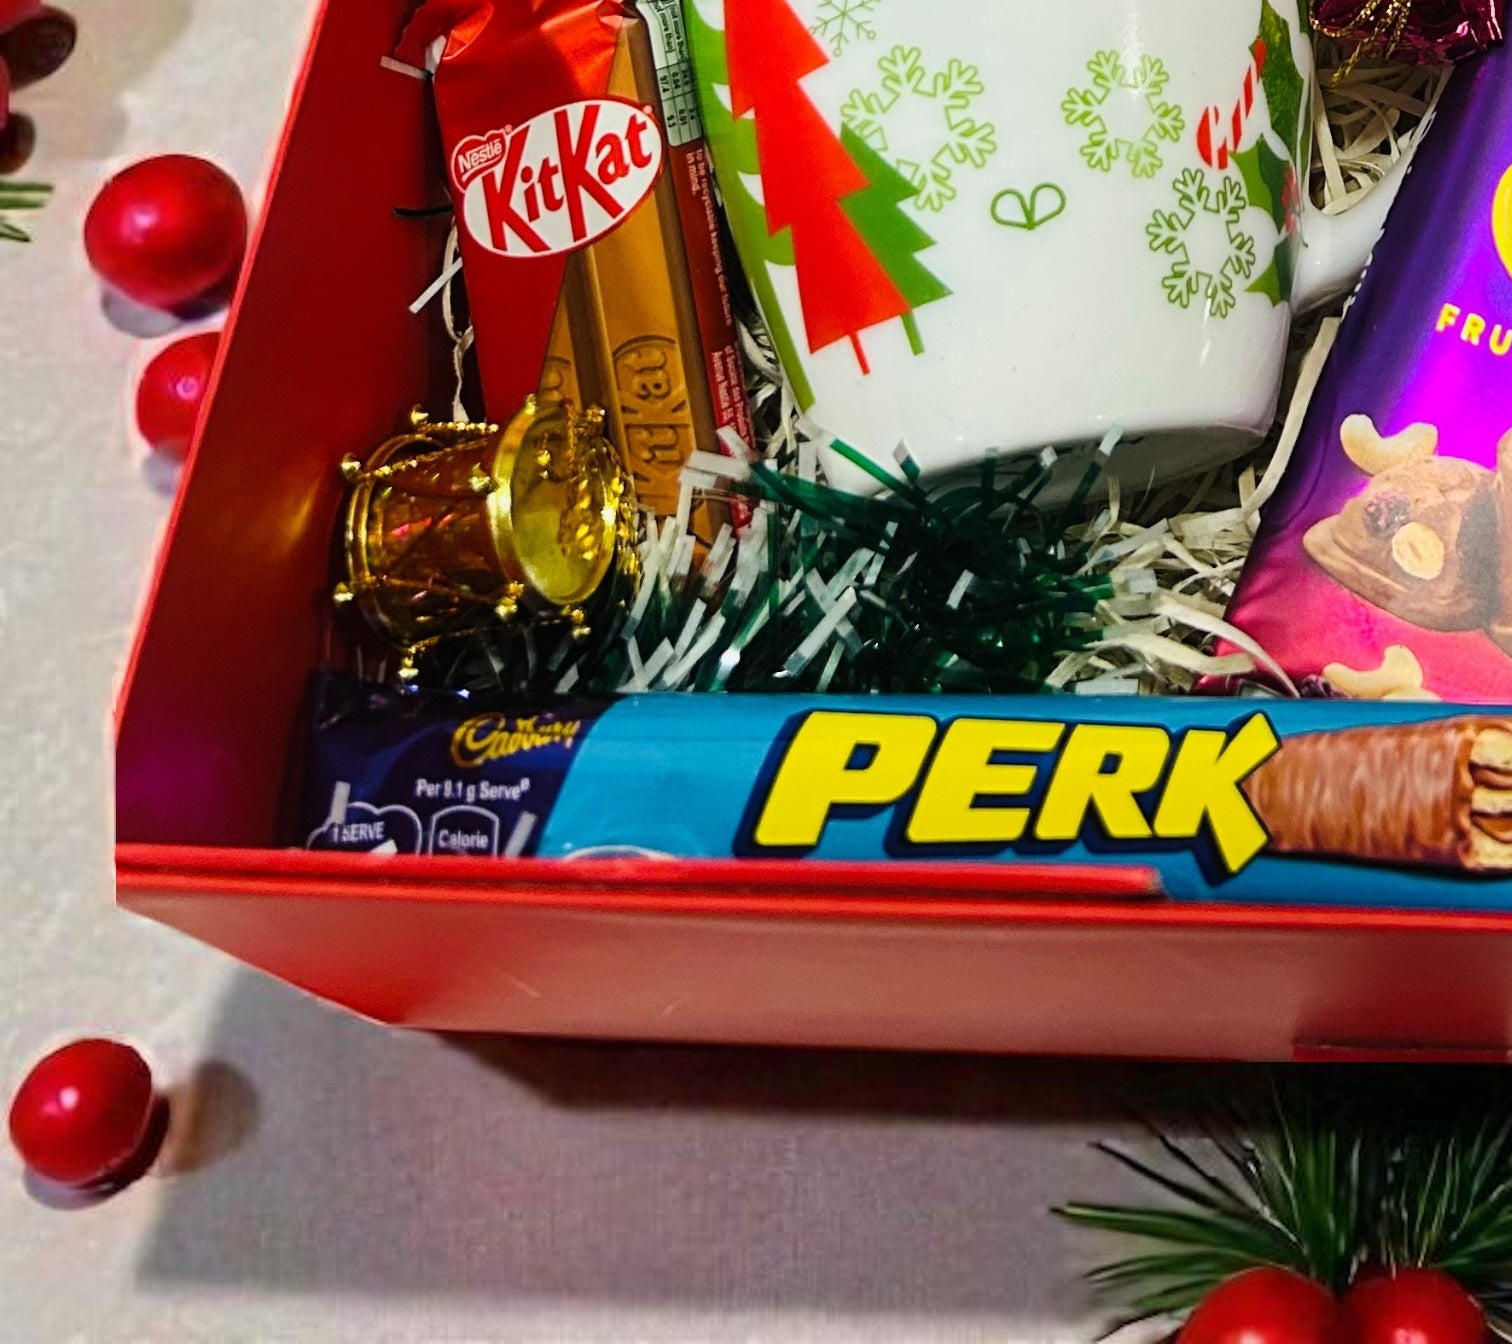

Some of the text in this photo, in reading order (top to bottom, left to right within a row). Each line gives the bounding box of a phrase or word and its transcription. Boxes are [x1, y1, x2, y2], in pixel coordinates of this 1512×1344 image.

[457, 138, 502, 173] Nestlé
[481, 104, 652, 253] KitKat
[452, 712, 581, 768] Cadbury
[416, 778, 442, 797] Per
[466, 783, 476, 803] g
[754, 711, 1280, 873] PERK
[341, 822, 385, 843] SERVE
[438, 829, 489, 849] Calorie
